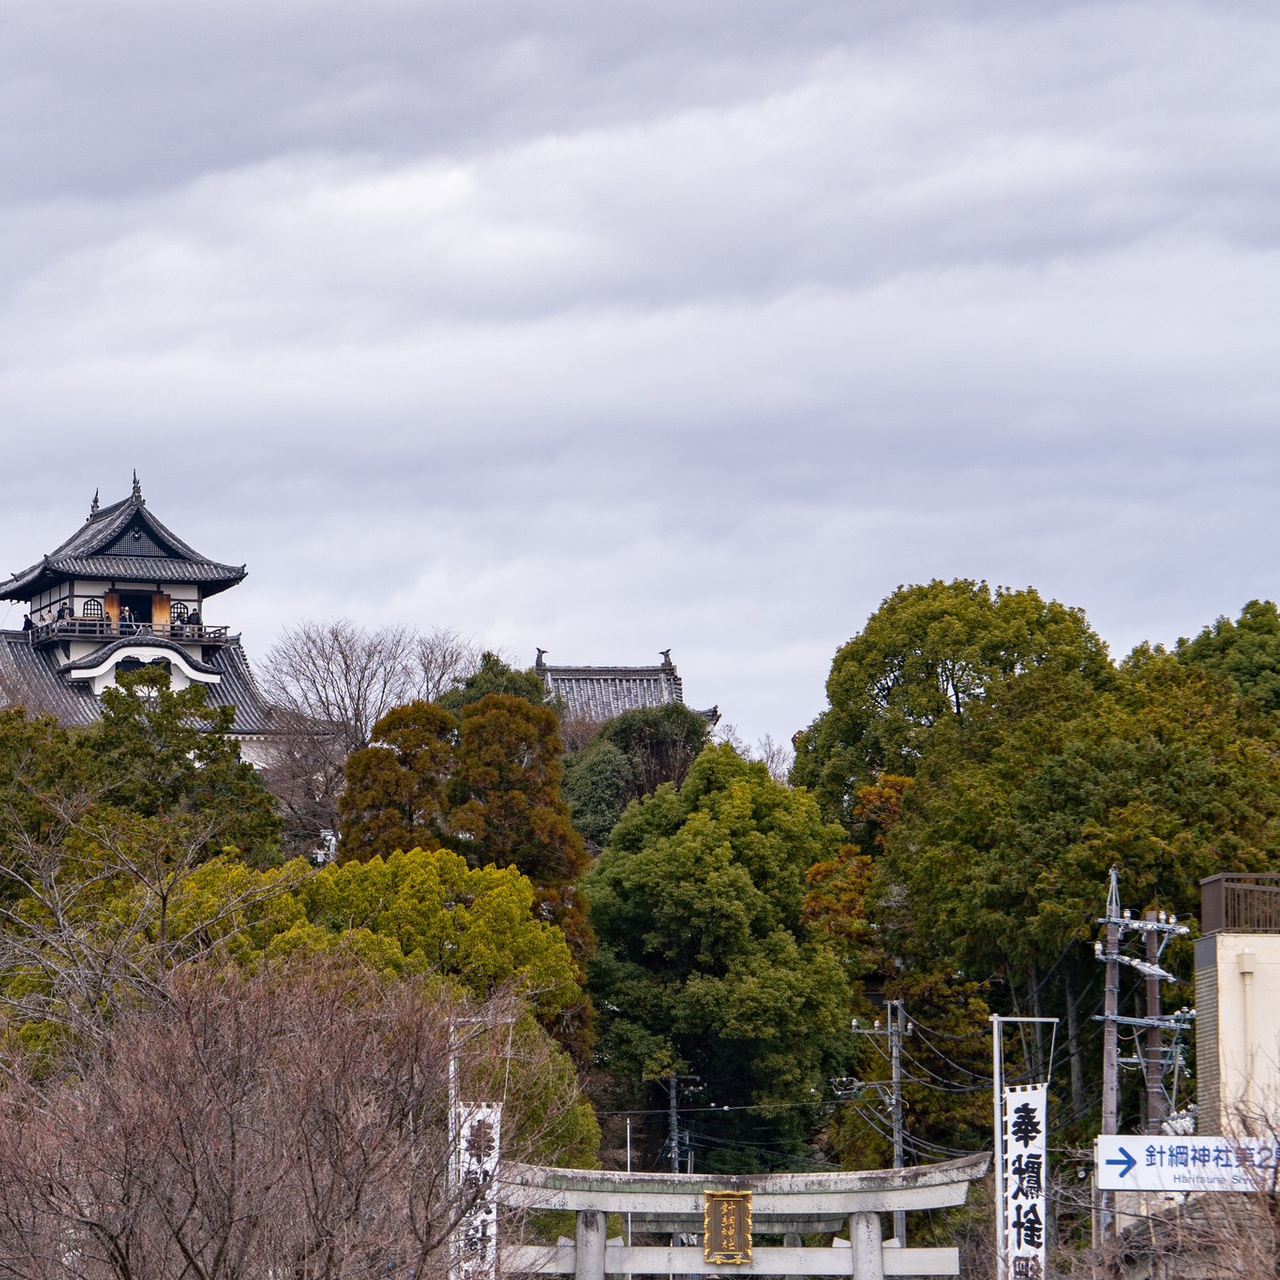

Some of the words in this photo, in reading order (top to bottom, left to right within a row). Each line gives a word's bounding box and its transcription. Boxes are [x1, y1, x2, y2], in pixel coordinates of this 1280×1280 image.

[1145, 1145, 1280, 1169] 針綱神社第2
